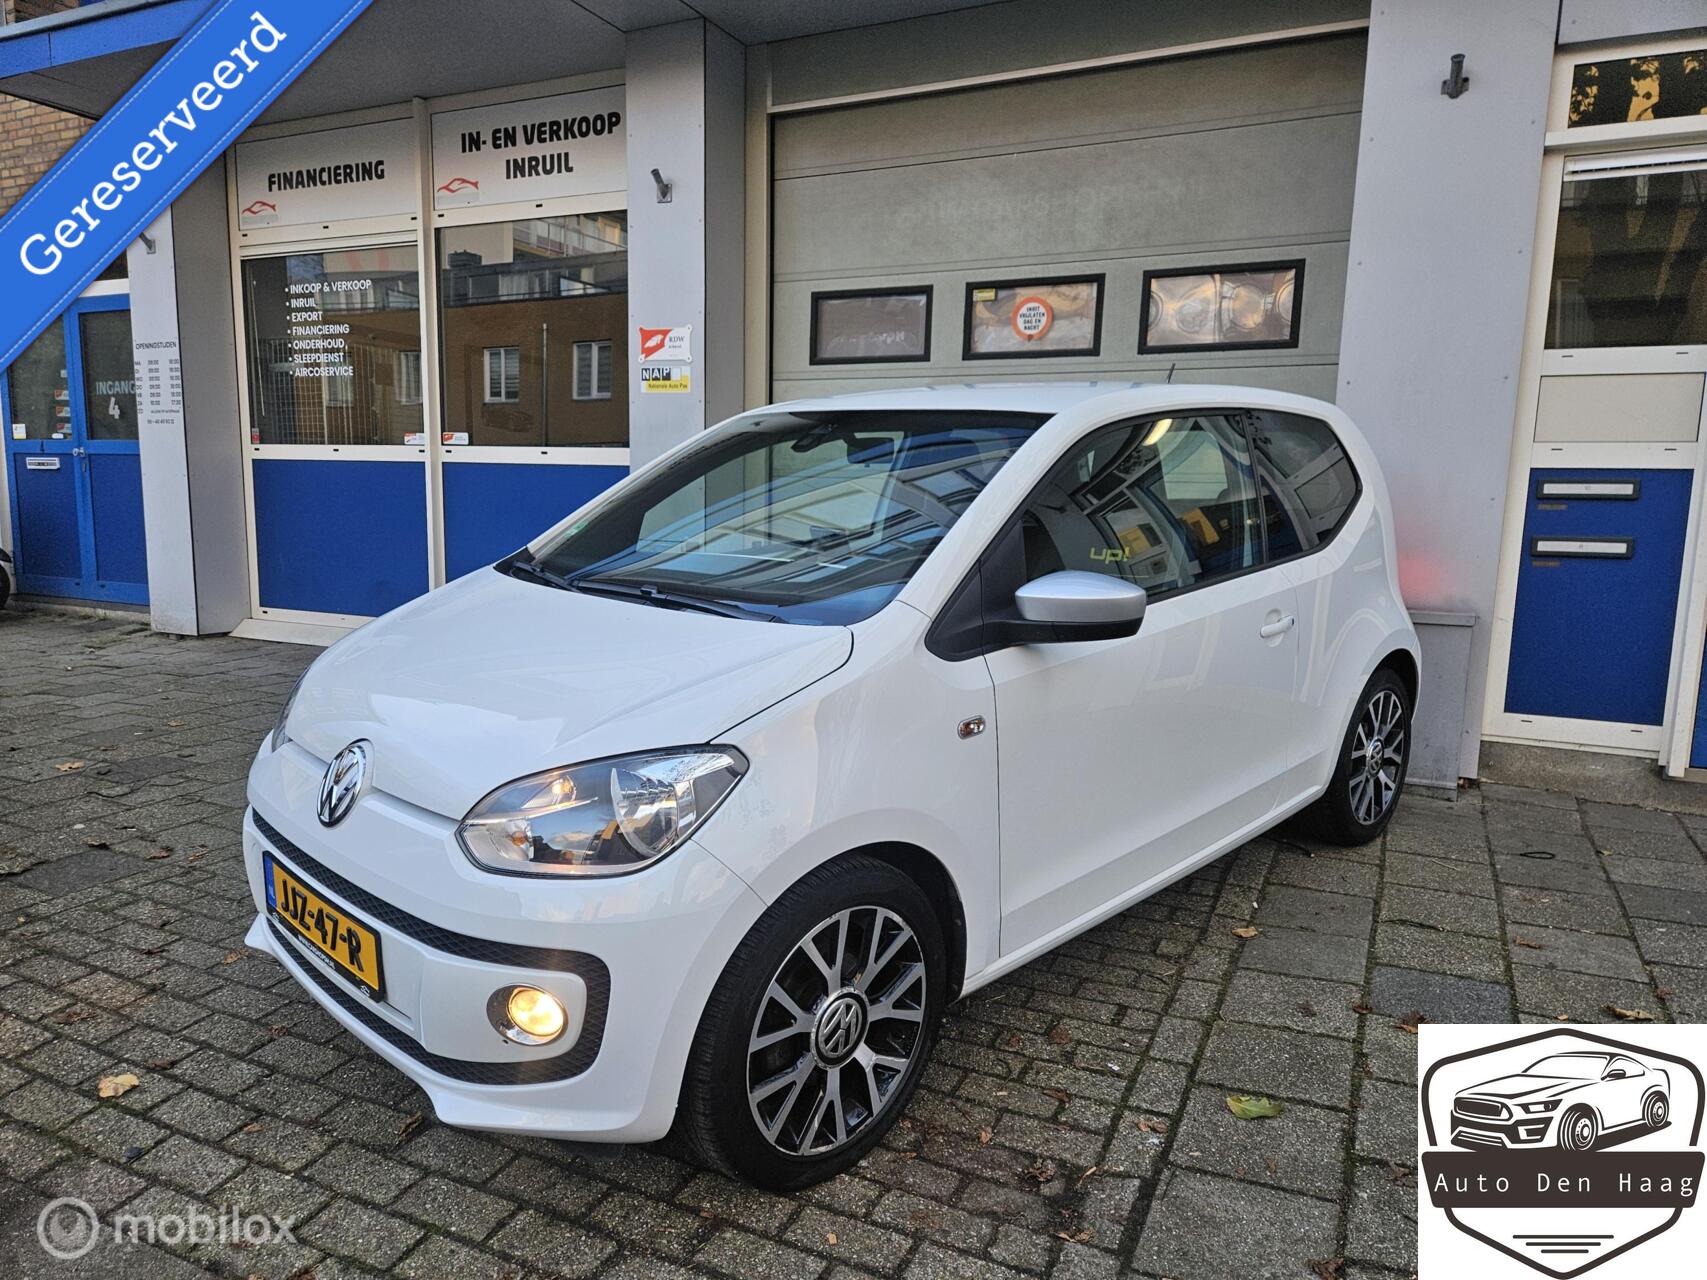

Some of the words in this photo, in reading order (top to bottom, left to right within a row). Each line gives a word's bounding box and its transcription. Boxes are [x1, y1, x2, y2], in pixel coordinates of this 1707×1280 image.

[461, 131, 487, 153] IN-
[491, 126, 517, 149] EN
[523, 111, 621, 145] VERKOOP
[506, 152, 574, 179] INRUIL
[268, 160, 385, 192] FINANCIERING
[290, 283, 322, 294] INKOOP
[323, 282, 330, 292] &
[331, 279, 372, 291] VERKOOP
[291, 298, 316, 308] INRUIL
[292, 311, 322, 322] EXPORT
[292, 324, 350, 335] FINANCIERING
[293, 338, 345, 349] ONDERHOUD
[293, 352, 344, 363] SLEEPDIENST
[294, 366, 354, 376] AIRCOSERVICE
[642, 367, 671, 381] NAP
[96, 380, 136, 395] INGANG
[108, 396, 120, 419] 4
[1089, 546, 1130, 564] up!
[281, 878, 364, 972] JJZ-47-R
